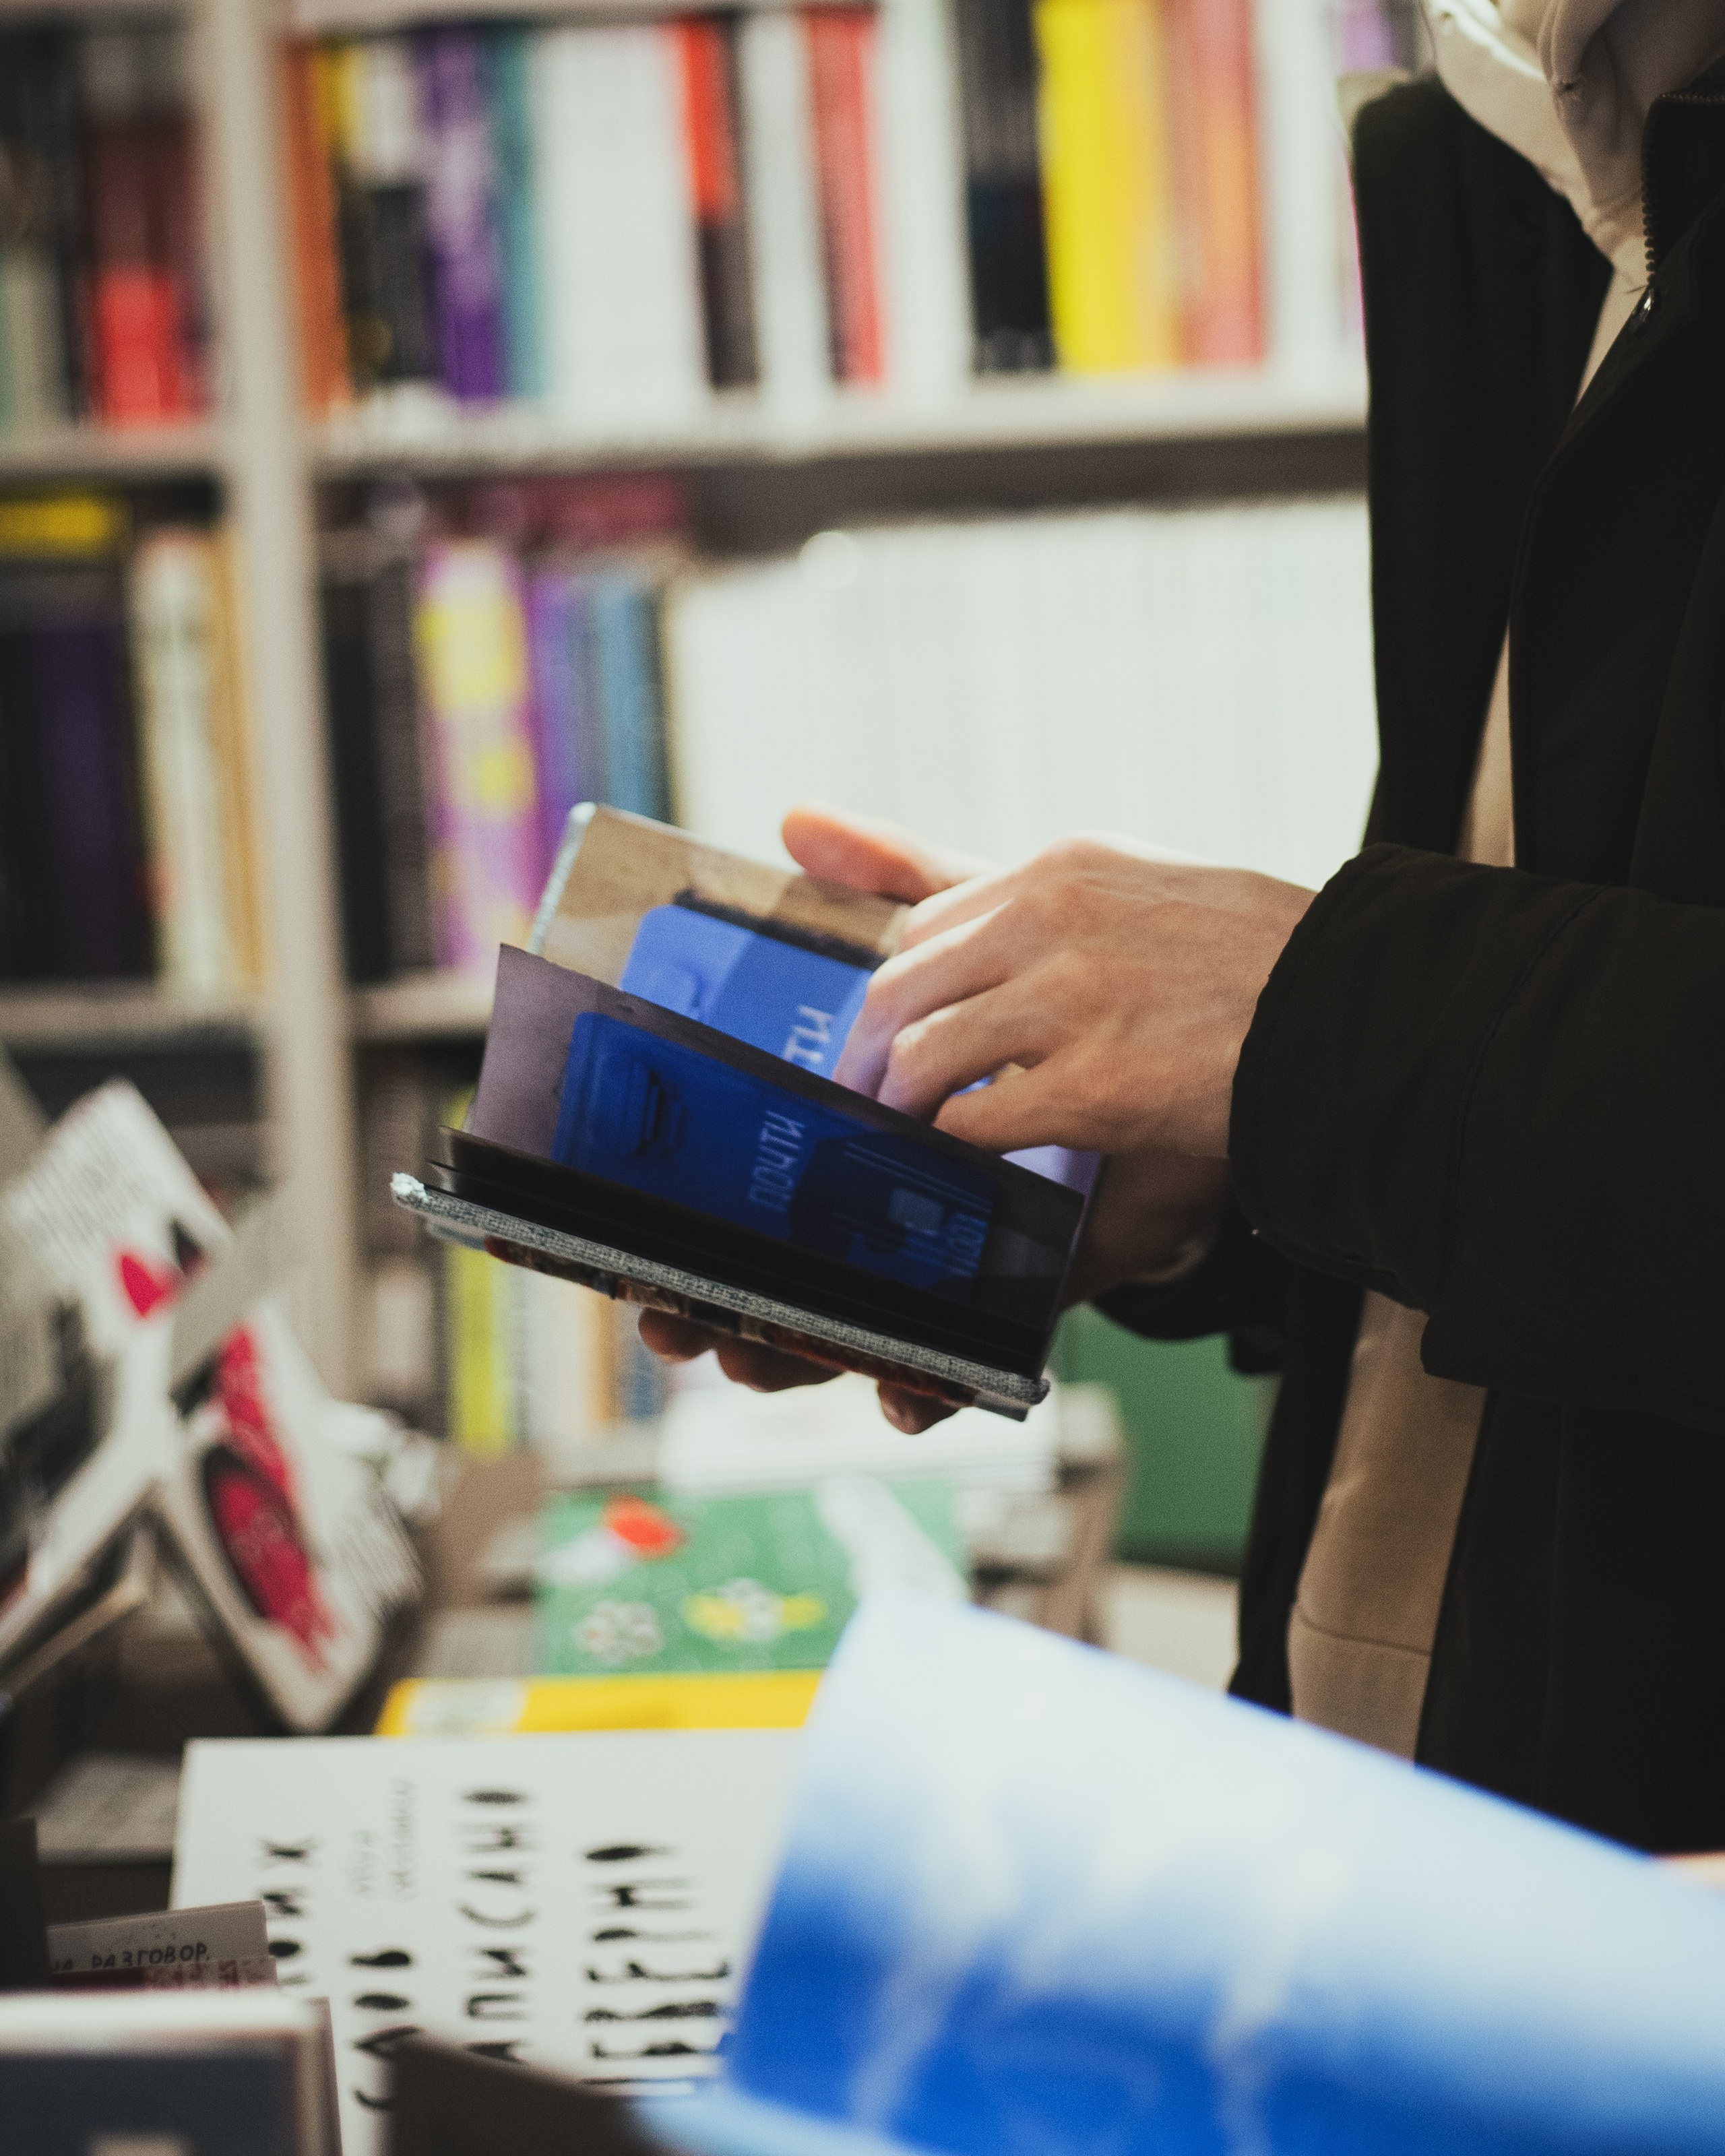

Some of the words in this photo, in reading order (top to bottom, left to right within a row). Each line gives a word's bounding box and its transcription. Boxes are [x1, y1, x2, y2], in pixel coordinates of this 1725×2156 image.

[747, 1110, 806, 1211] ПОЧТИ
[260, 1837, 323, 1988] ОИХ
[460, 1789, 537, 2063] АПИСАНО
